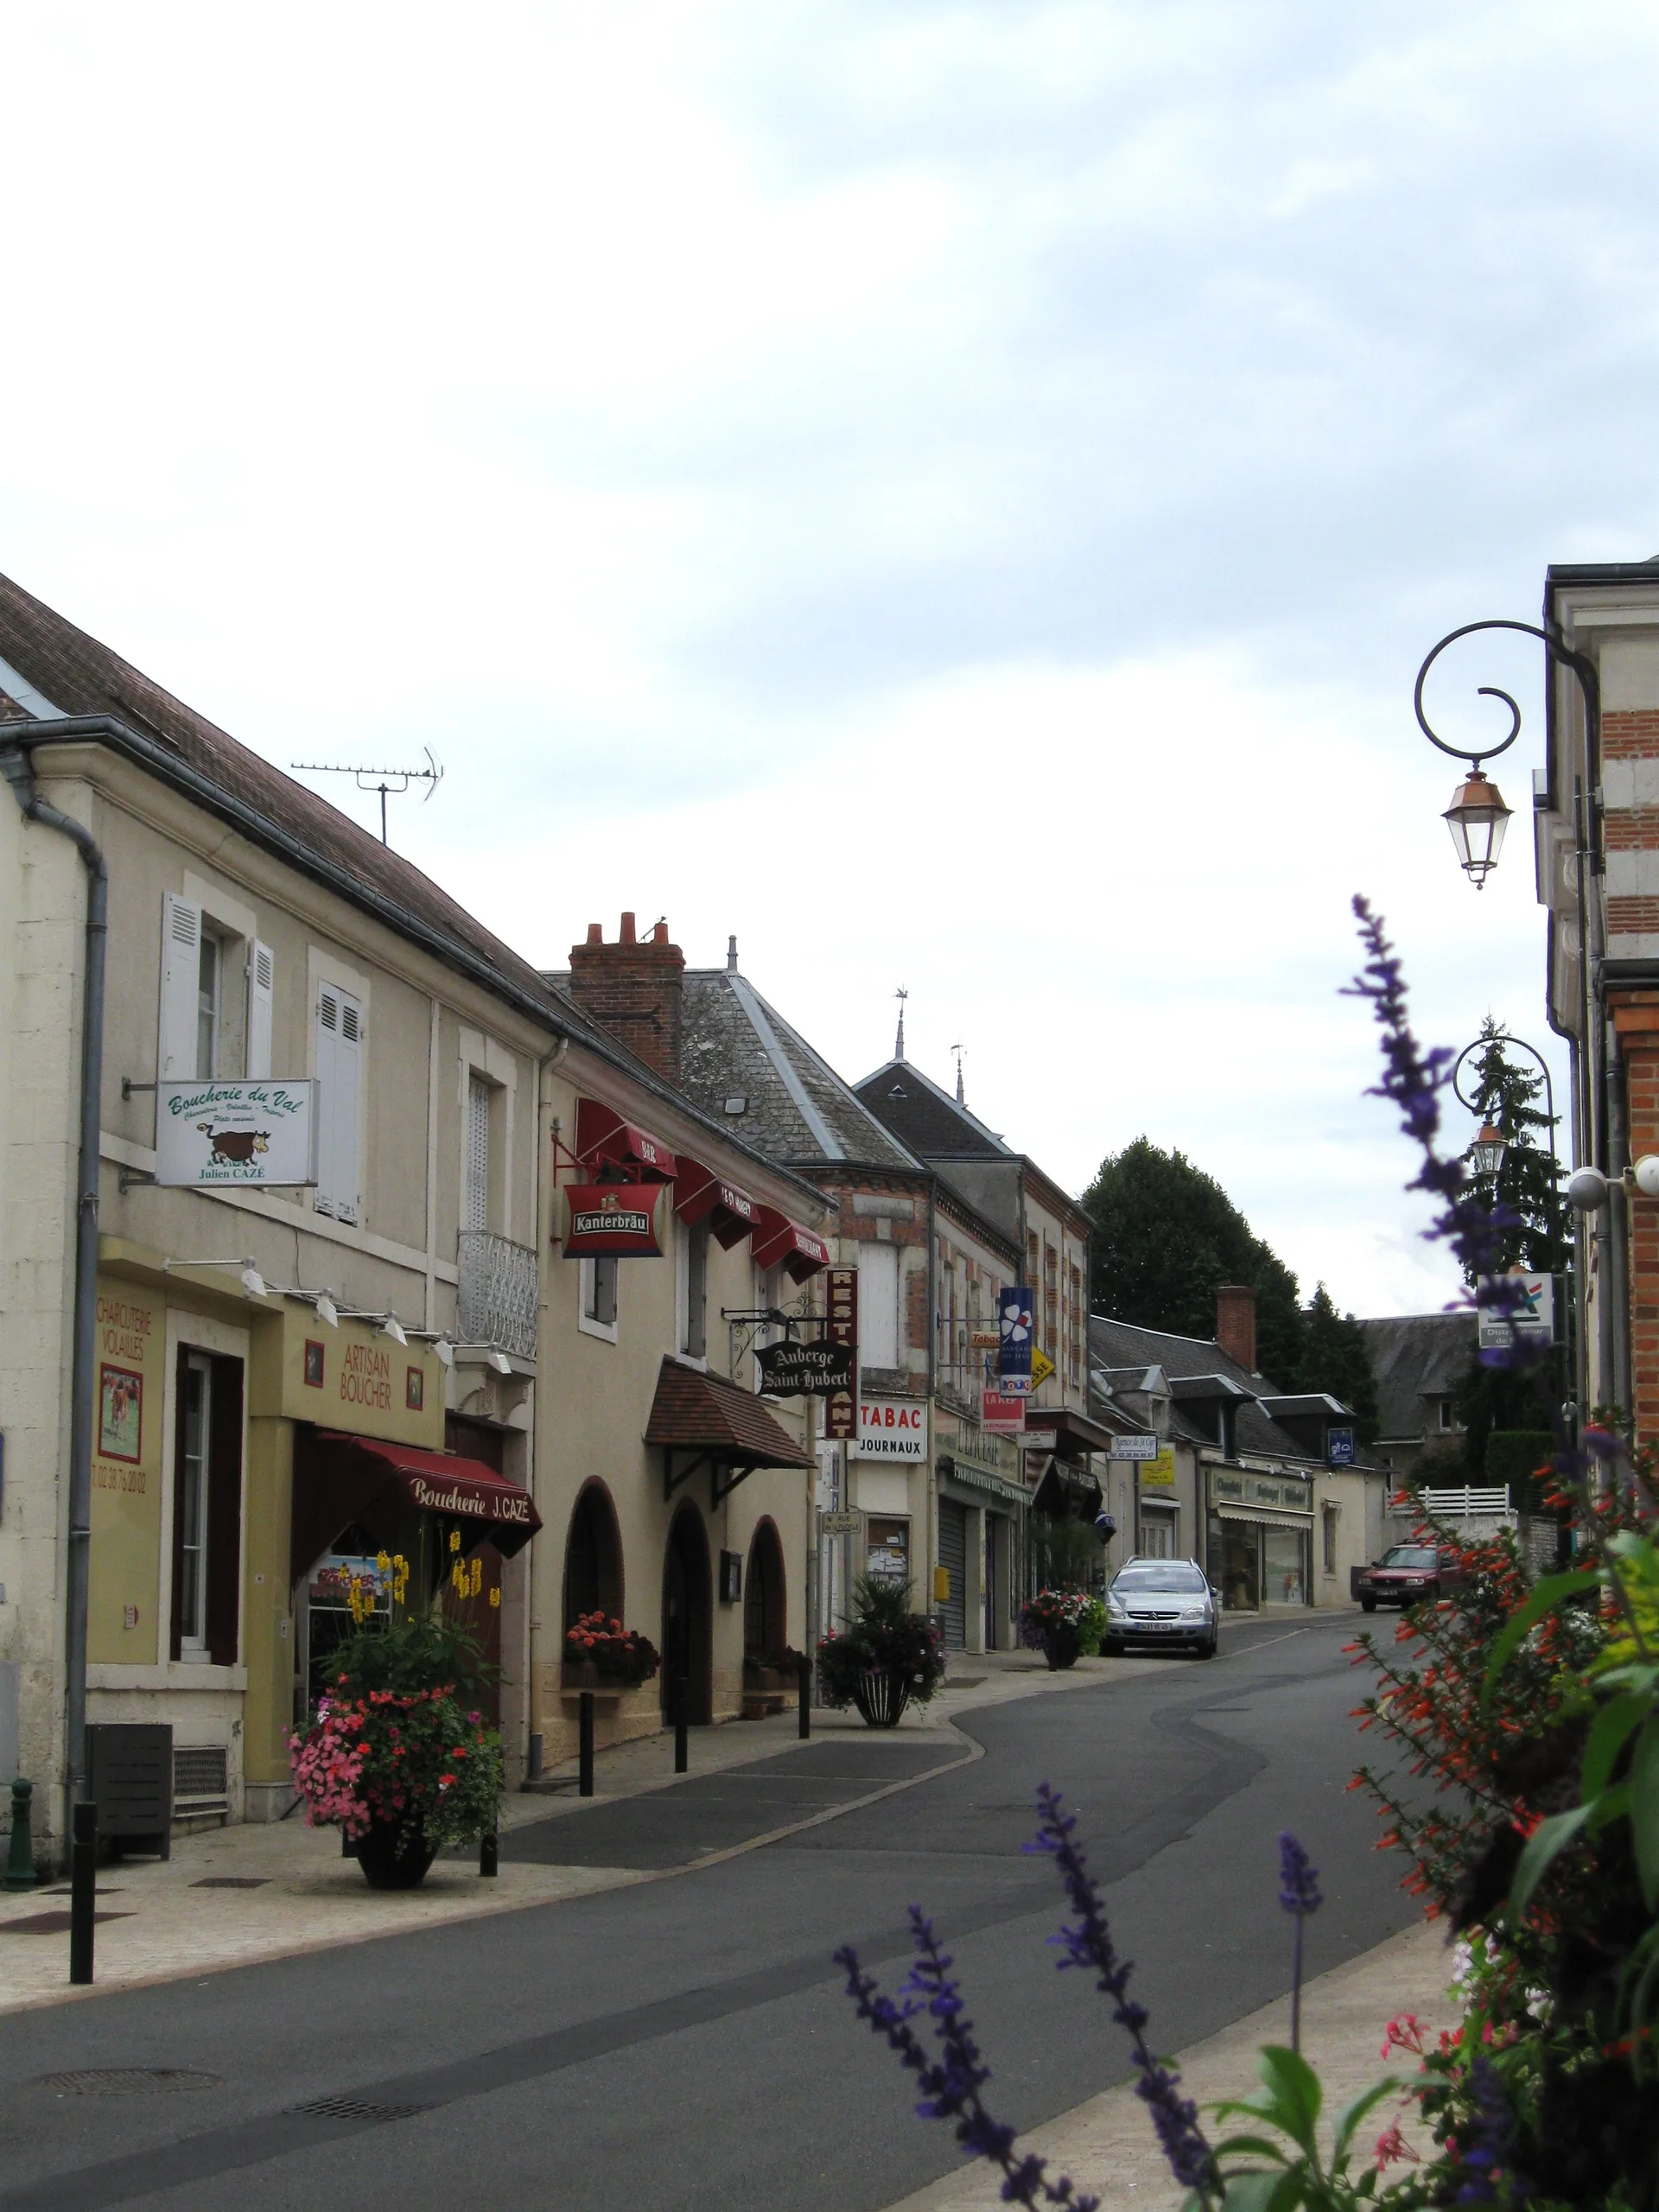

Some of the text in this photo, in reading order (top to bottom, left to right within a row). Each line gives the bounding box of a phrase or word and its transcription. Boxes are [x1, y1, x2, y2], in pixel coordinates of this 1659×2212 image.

[168, 1085, 303, 1115] Boucherie du Val
[641, 1141, 657, 1163] BAR
[199, 1166, 265, 1179] Julien CAZÉ
[576, 1215, 645, 1231] Kanterbräu
[96, 1297, 151, 1335] CHARCUTERIE
[103, 1329, 143, 1362] VOLAILLES
[831, 1271, 852, 1438] RESTANT
[344, 1344, 390, 1379] ARTISAN
[774, 1350, 834, 1368] Auberge
[340, 1372, 391, 1409] BOUCHER
[763, 1370, 849, 1390] Saint-Hubert
[1002, 1380, 1031, 1390] LOTO
[986, 1395, 996, 1404] LA
[861, 1406, 920, 1428] TABAC
[860, 1439, 920, 1454] JOURNAUX
[410, 1478, 486, 1516] Boucherie
